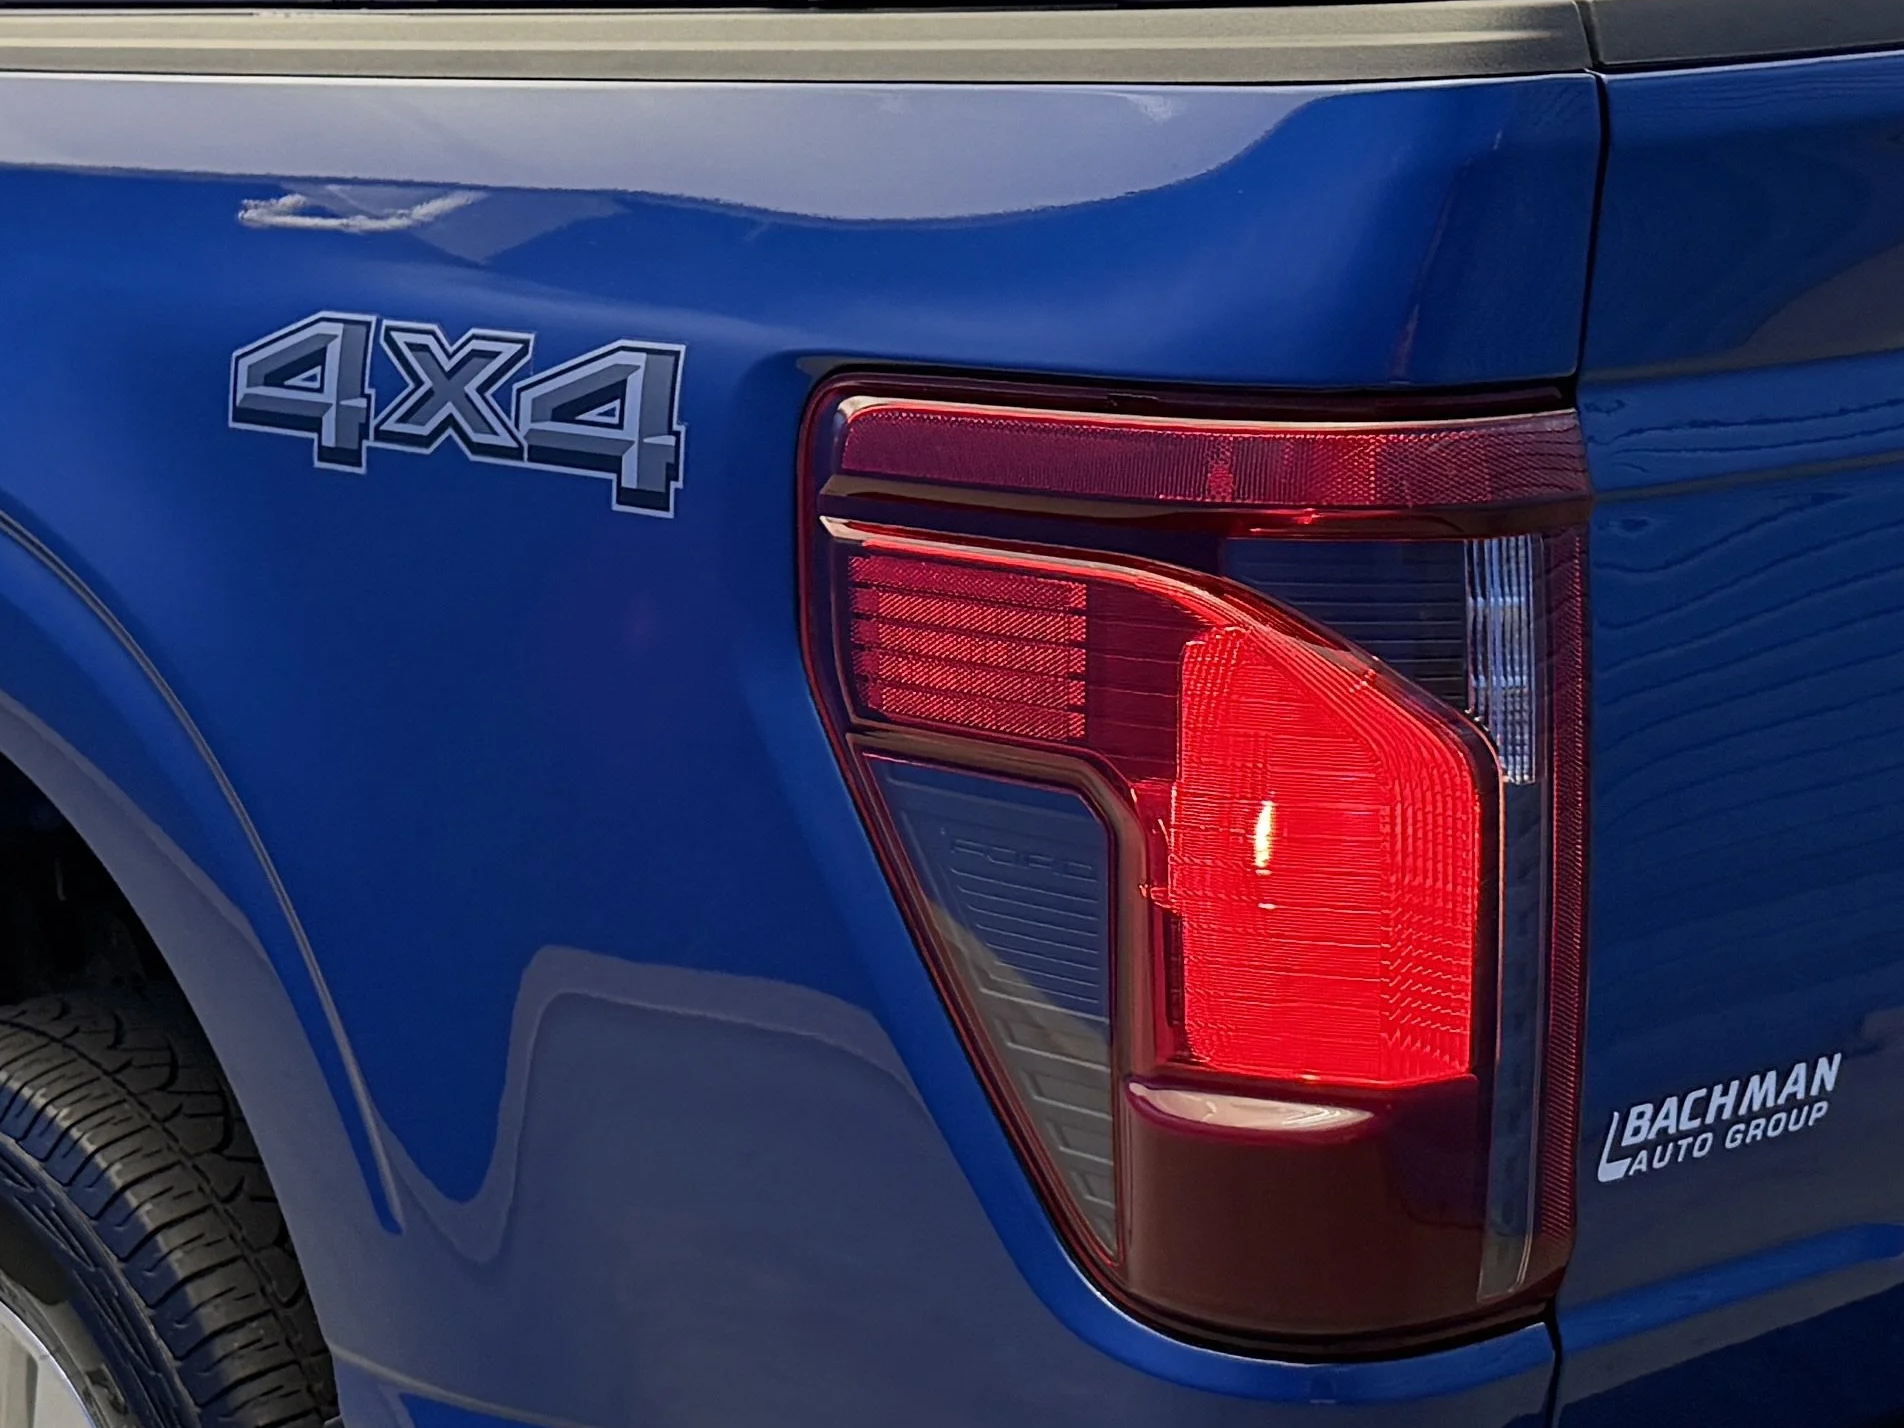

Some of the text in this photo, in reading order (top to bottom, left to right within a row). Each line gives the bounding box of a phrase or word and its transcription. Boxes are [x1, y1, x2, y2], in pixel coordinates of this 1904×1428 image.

[1620, 1052, 1843, 1148] BACHMAN
[1628, 1100, 1829, 1177] AUTO GROUP
